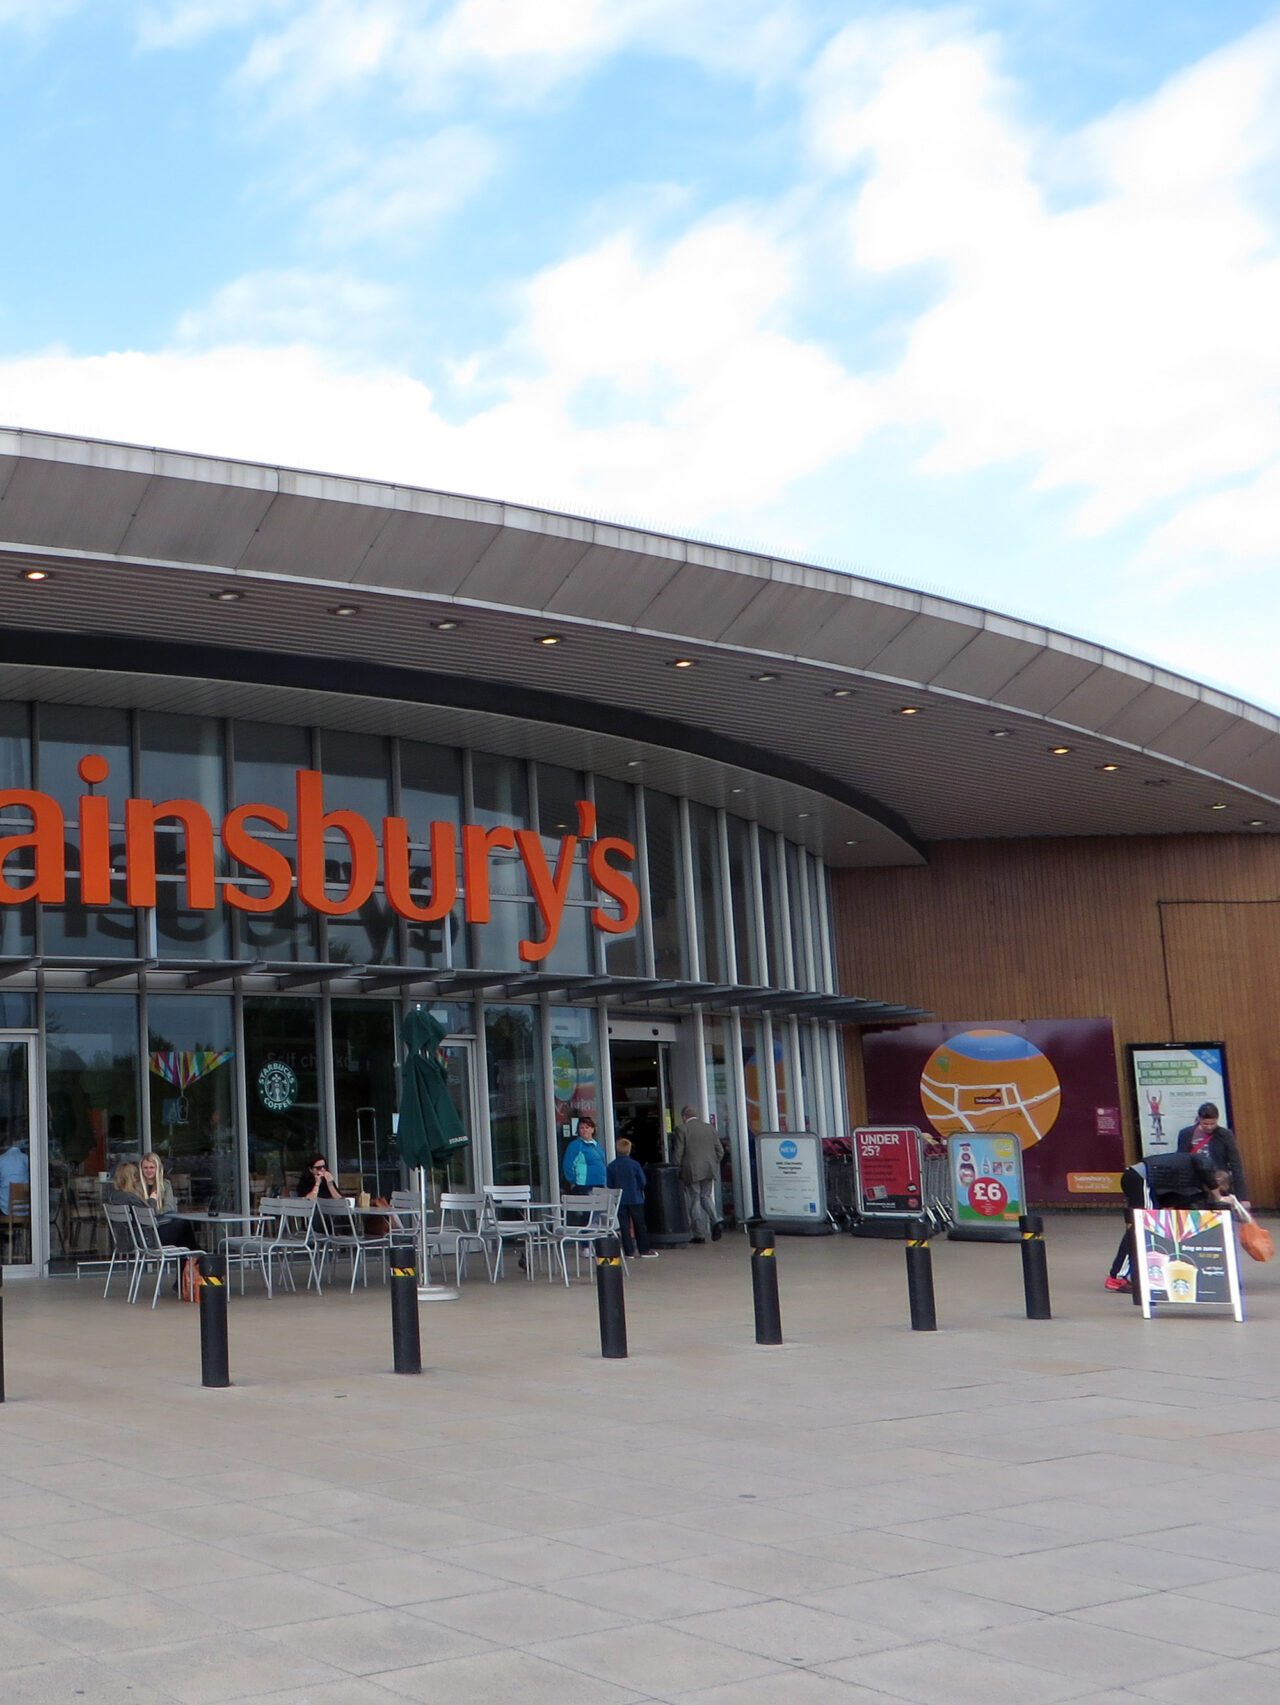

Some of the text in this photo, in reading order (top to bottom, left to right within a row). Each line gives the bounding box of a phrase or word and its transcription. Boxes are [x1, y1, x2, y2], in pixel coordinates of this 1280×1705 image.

[258, 1062, 295, 1084] STARBUCKS
[263, 1097, 293, 1110] COFFEE
[860, 1134, 900, 1145] UNDER
[861, 1146, 880, 1157] 25?
[974, 1183, 1002, 1201] £6
